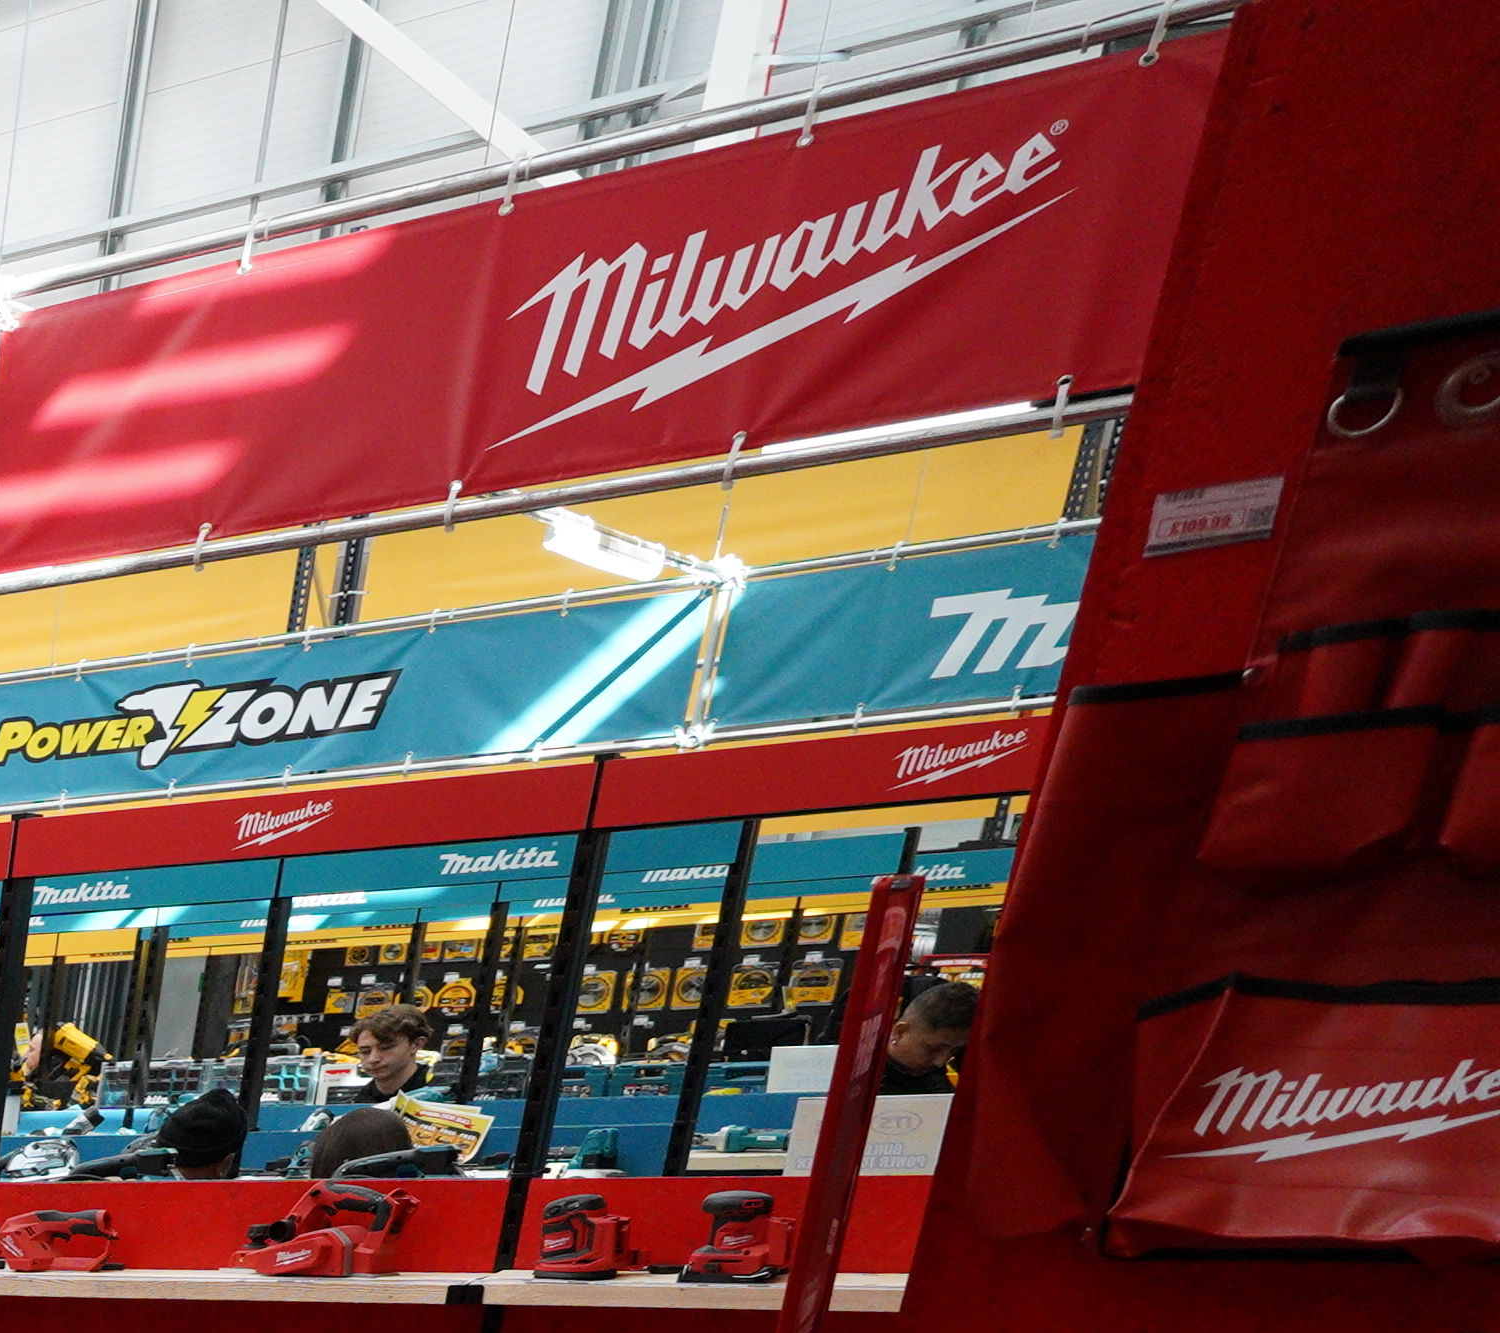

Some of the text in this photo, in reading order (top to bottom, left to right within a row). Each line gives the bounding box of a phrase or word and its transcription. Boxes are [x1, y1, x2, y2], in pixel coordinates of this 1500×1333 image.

[507, 133, 1062, 394] Milwaukee
[185, 673, 396, 749] ZONE
[895, 731, 1028, 778] Milwaukee
[234, 800, 334, 843] Milwaukee
[439, 846, 560, 876] makita
[915, 862, 965, 884] kita
[32, 877, 130, 907] makita
